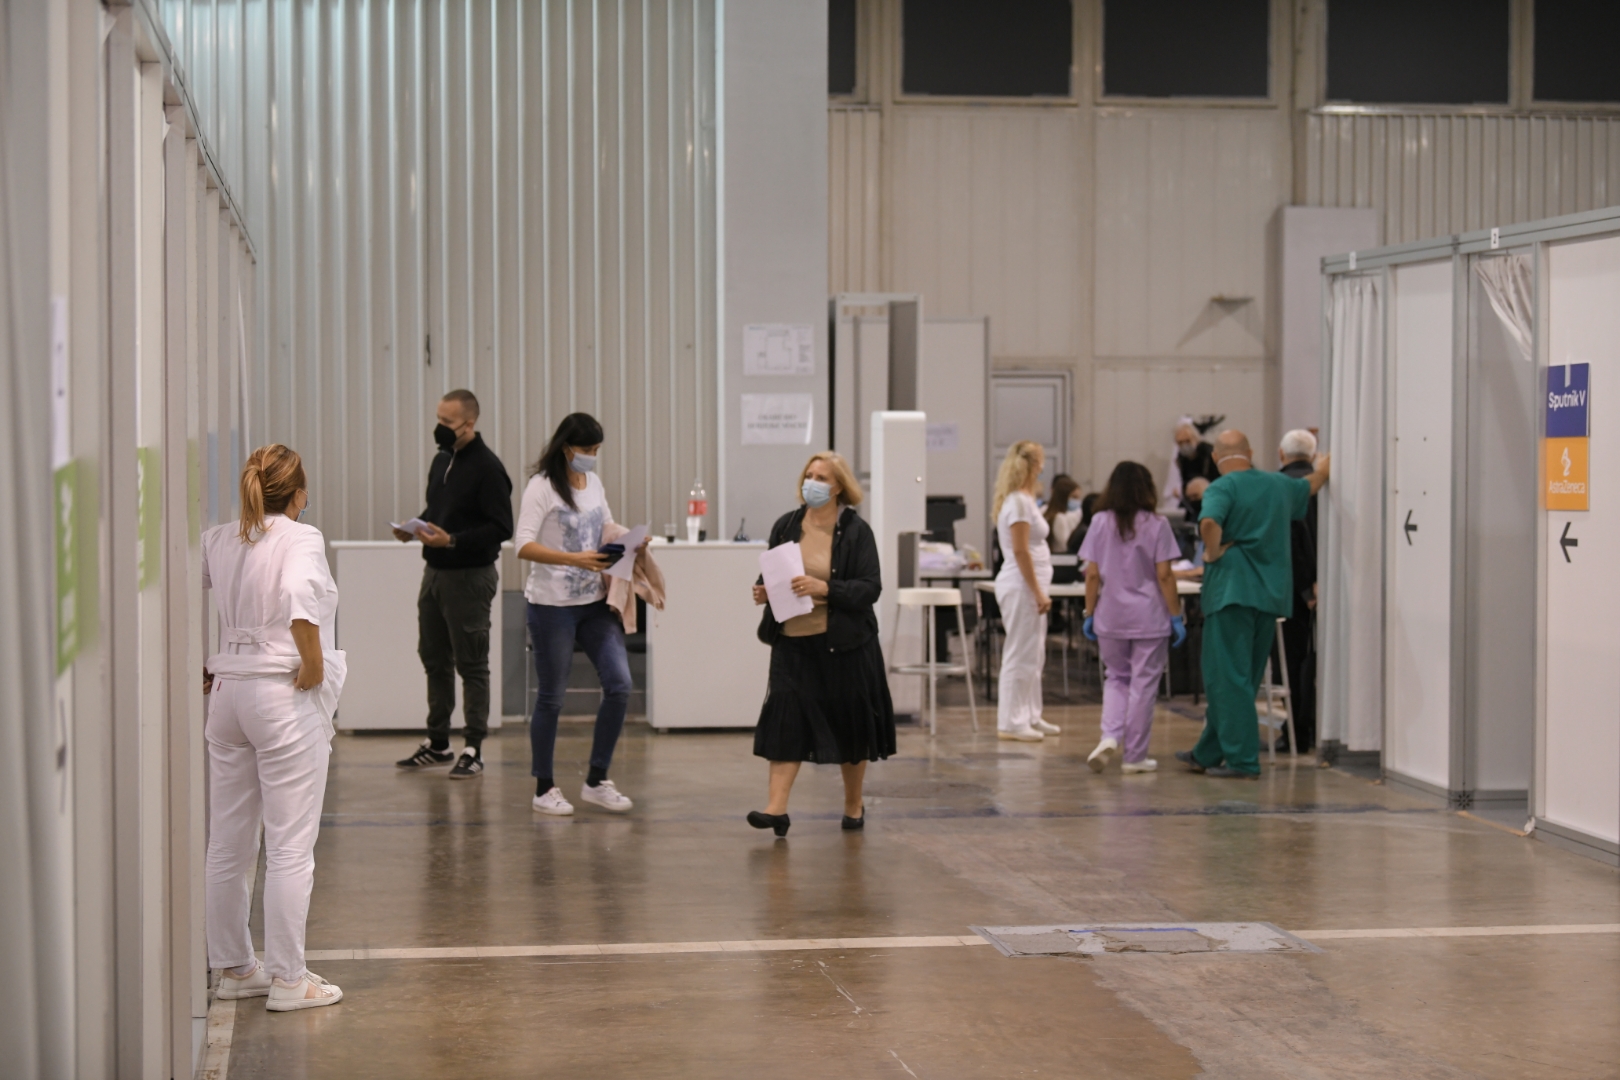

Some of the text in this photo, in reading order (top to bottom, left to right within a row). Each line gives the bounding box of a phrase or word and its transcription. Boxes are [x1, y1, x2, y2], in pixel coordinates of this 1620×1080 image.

[1548, 389, 1586, 411] Sputnik V
[1548, 480, 1585, 494] AstraZeneca
